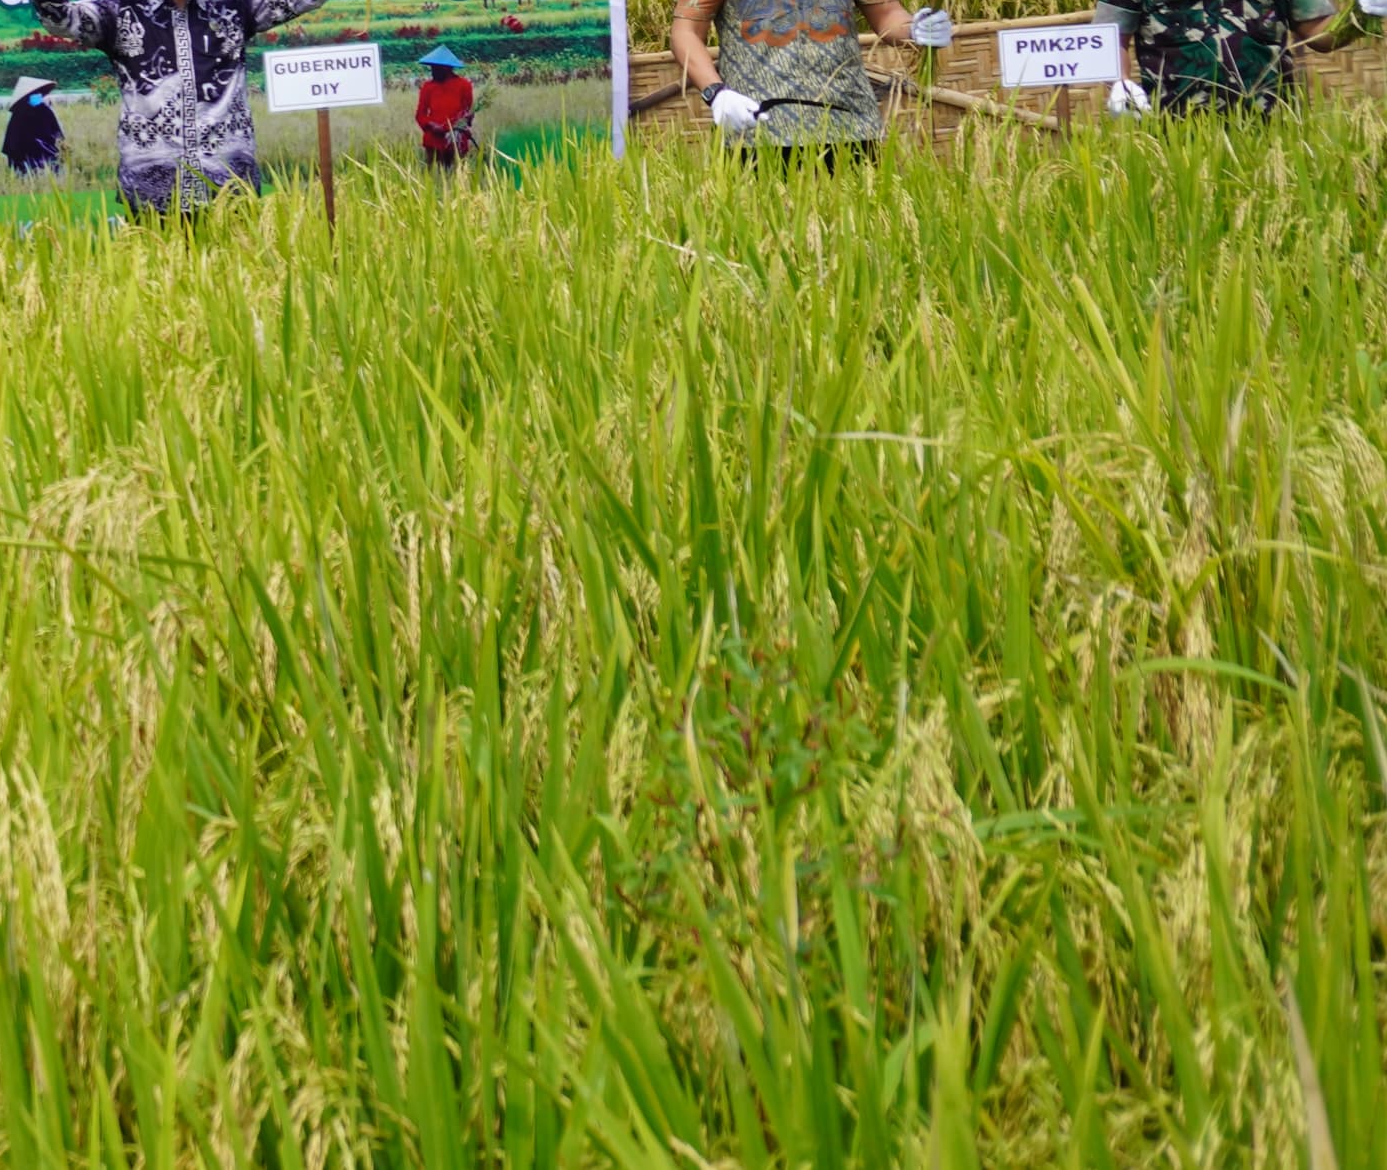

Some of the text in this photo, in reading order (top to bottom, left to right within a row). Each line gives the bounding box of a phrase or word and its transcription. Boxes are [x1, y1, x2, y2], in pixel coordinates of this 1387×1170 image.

[1015, 35, 1103, 54] PMK2PS
[273, 56, 372, 75] GUBERNUR
[1043, 62, 1079, 78] DIY
[311, 82, 340, 96] DIY
